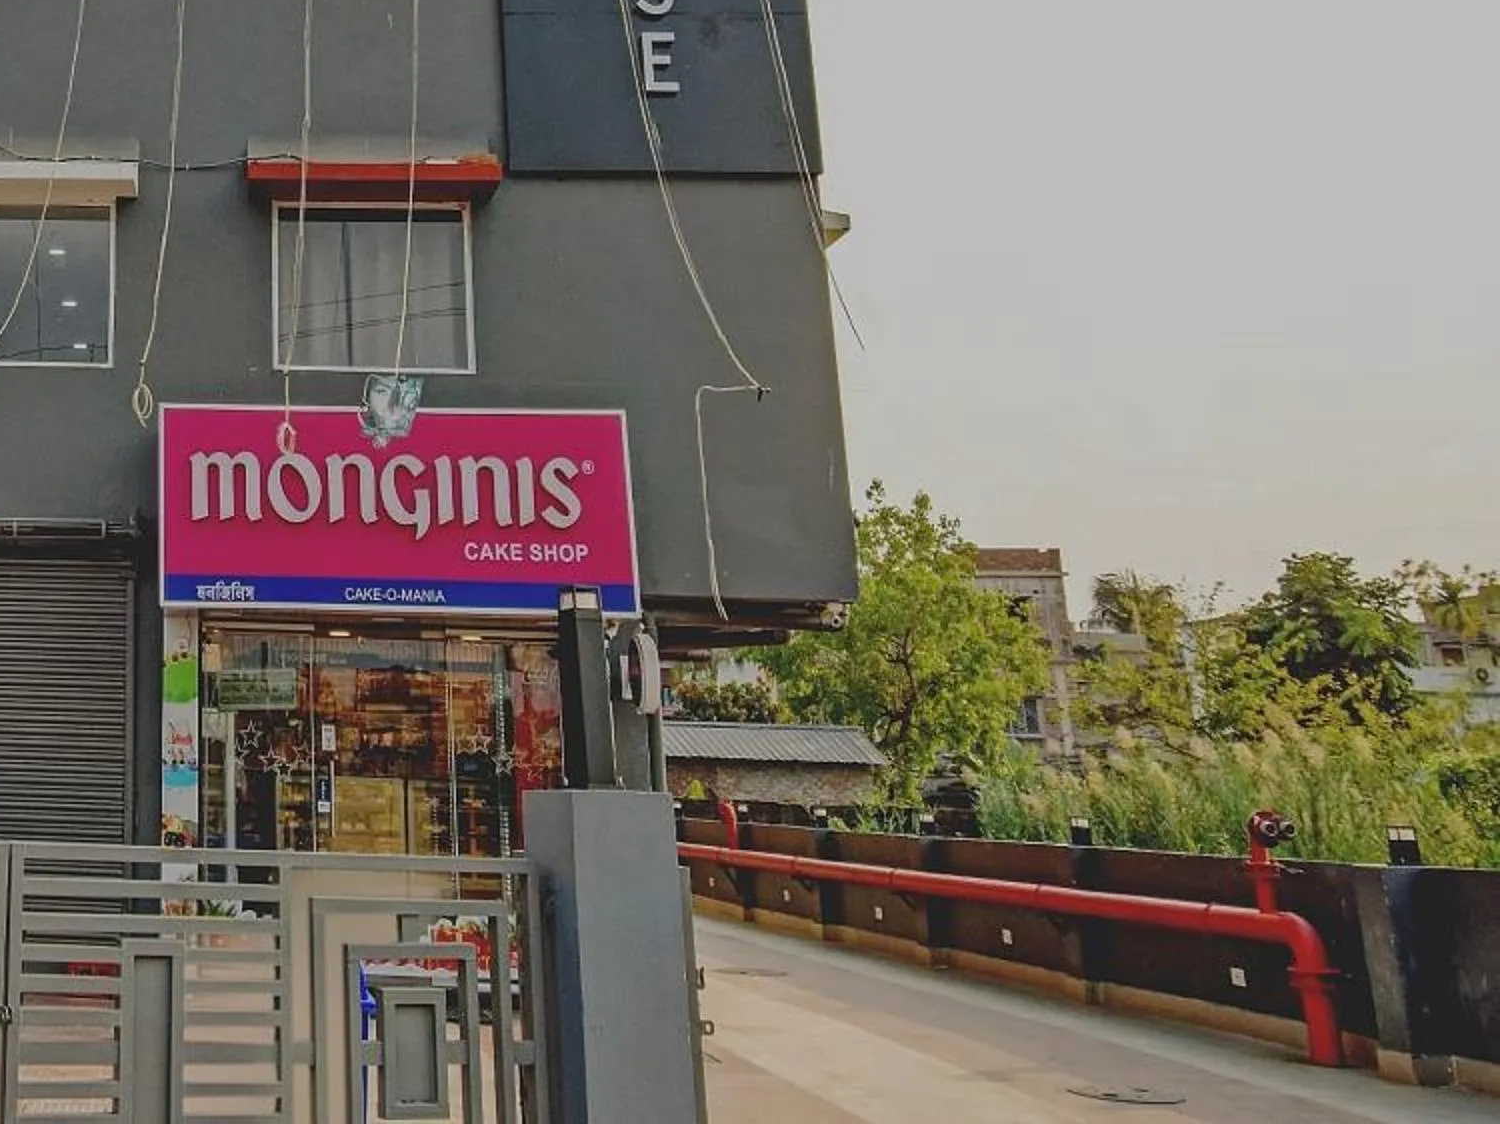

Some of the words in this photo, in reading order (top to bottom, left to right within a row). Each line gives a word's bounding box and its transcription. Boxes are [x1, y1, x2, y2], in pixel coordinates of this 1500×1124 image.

[463, 542, 524, 561] CAKE
[528, 542, 589, 563] SHOP
[344, 586, 447, 603] CAKE-O-MANIA
